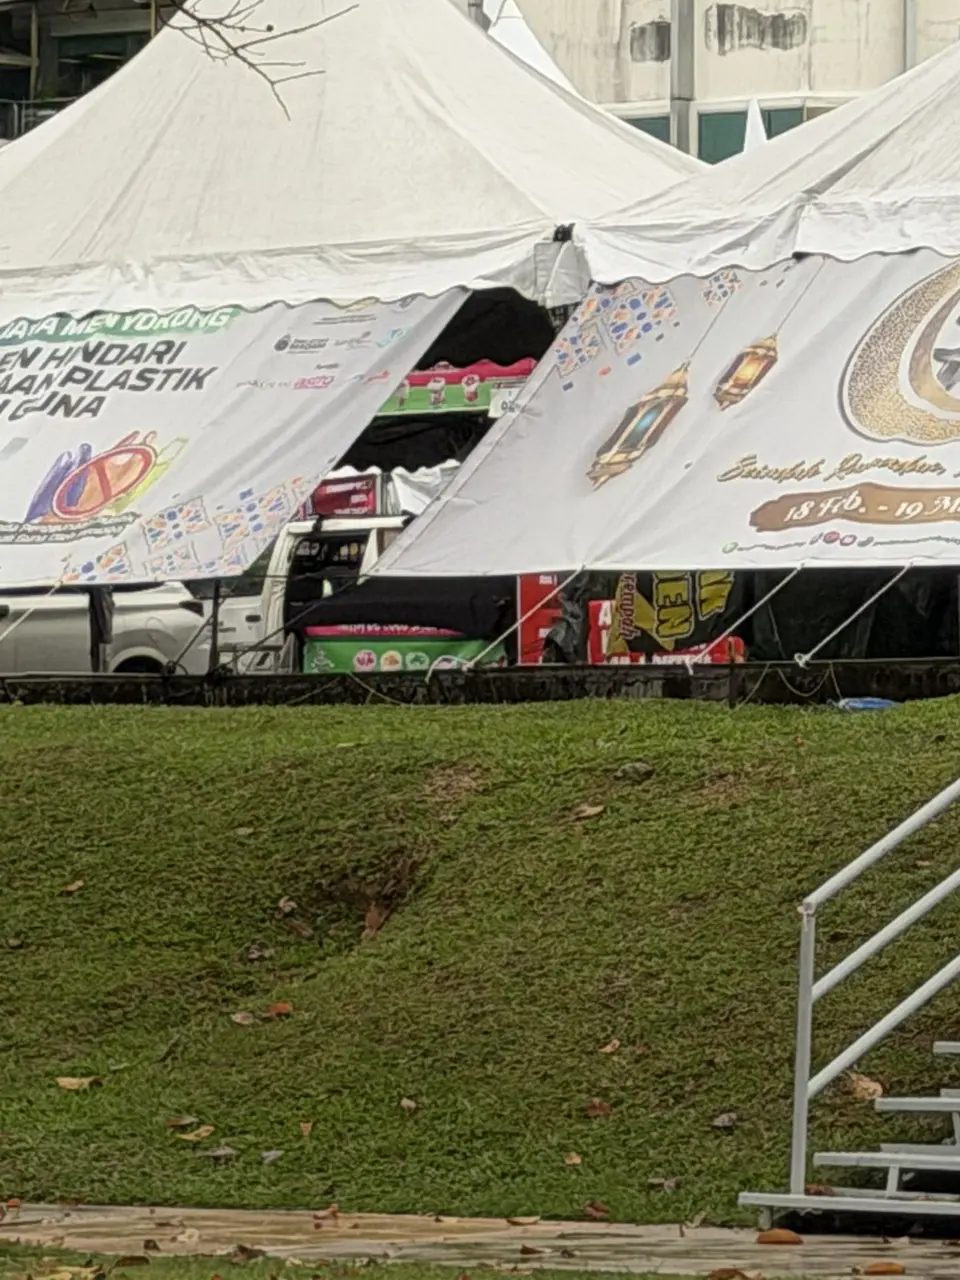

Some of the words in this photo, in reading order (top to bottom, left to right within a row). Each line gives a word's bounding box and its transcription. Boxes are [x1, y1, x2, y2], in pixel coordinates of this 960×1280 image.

[60, 307, 233, 336] MENYOKONG
[58, 365, 218, 392] PLASTIK
[784, 500, 816, 523] 18
[894, 501, 924, 521] 19
